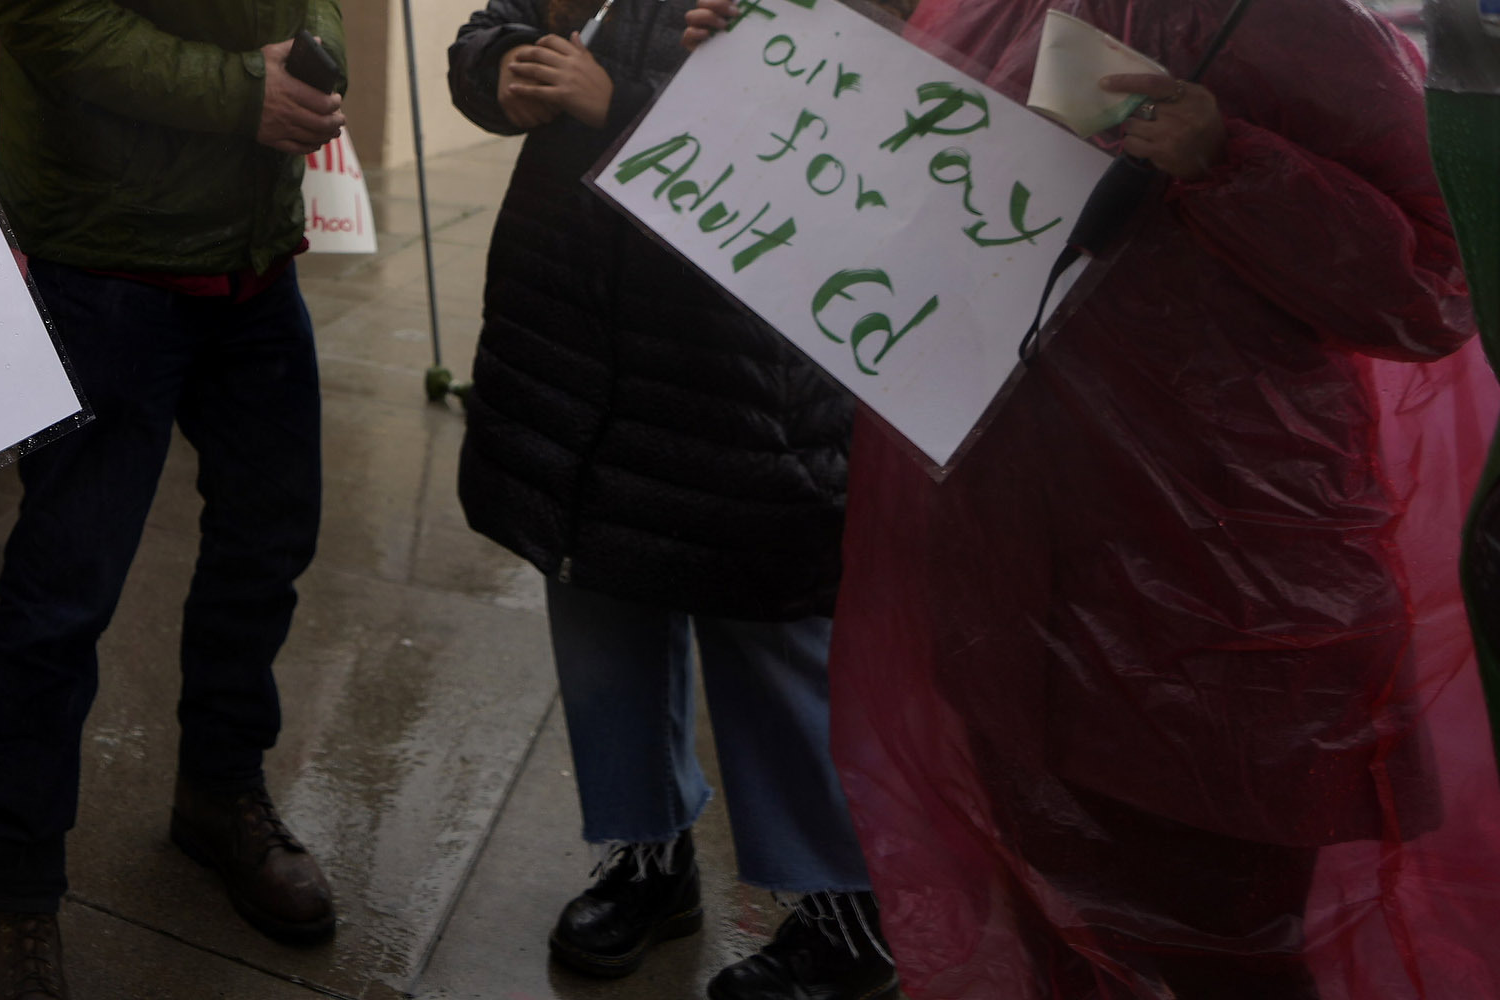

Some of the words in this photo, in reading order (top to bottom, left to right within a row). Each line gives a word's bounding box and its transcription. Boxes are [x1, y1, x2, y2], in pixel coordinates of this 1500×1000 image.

[756, 108, 889, 212] for
[879, 81, 1063, 248] Pay
[613, 132, 797, 274] Adult
[810, 267, 940, 376] Ed
